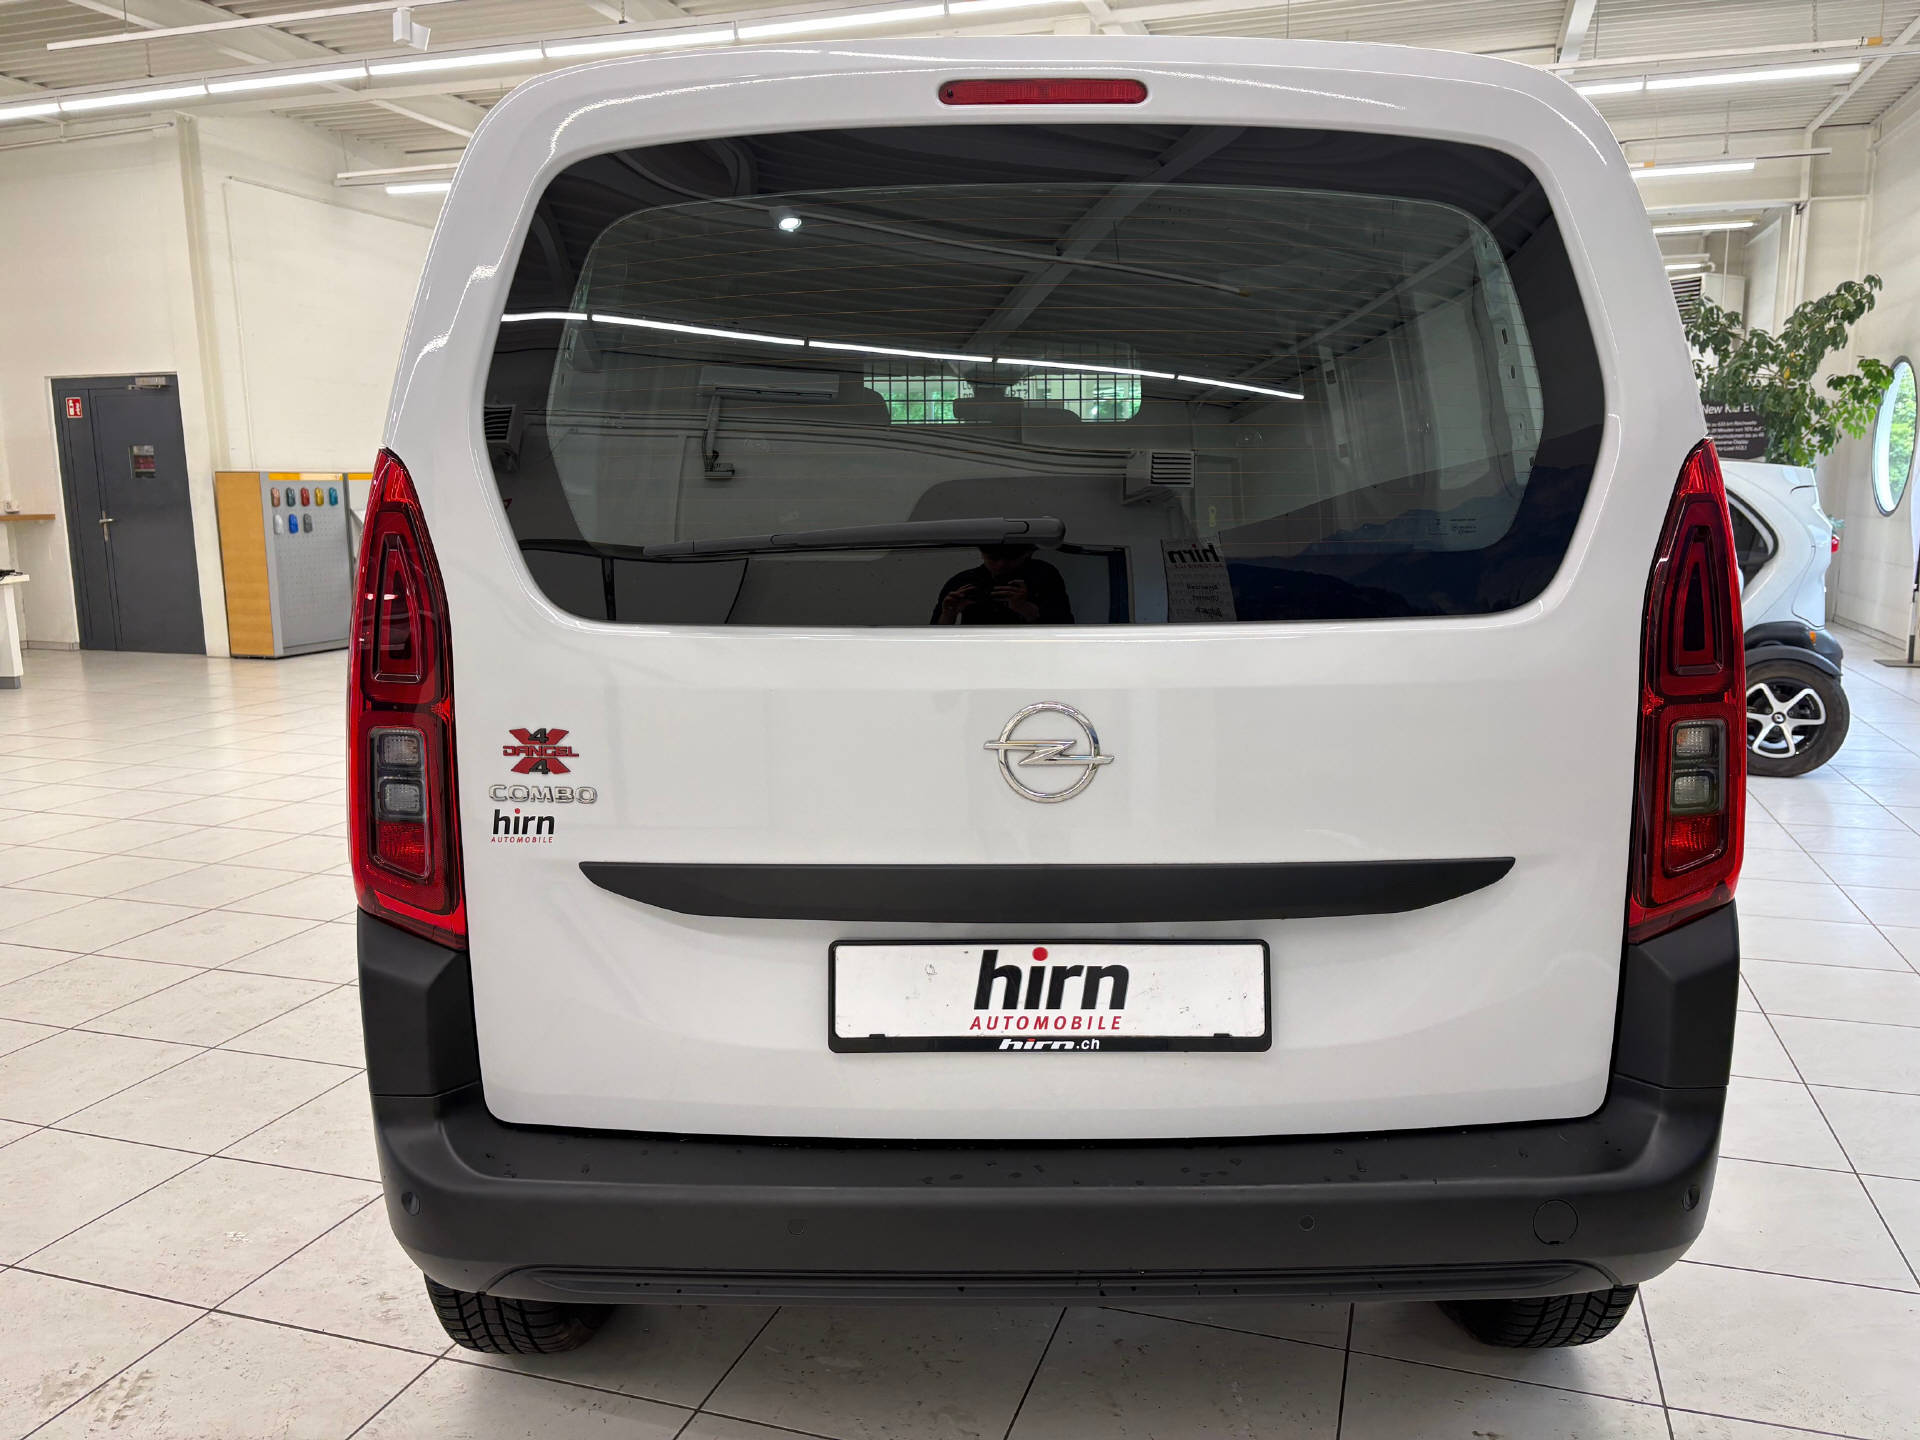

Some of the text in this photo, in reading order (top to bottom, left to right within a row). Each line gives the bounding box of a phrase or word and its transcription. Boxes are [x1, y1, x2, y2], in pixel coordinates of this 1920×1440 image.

[1703, 404, 1723, 414] New
[503, 745, 579, 758] DANGEL
[489, 784, 598, 804] COMBO
[492, 808, 555, 835] hirn
[491, 836, 553, 844] AUTOMOBILE
[974, 946, 1130, 1010] hirn
[970, 1015, 1122, 1030] AUTOMOBILE
[999, 1038, 1100, 1051] hirn.ch
